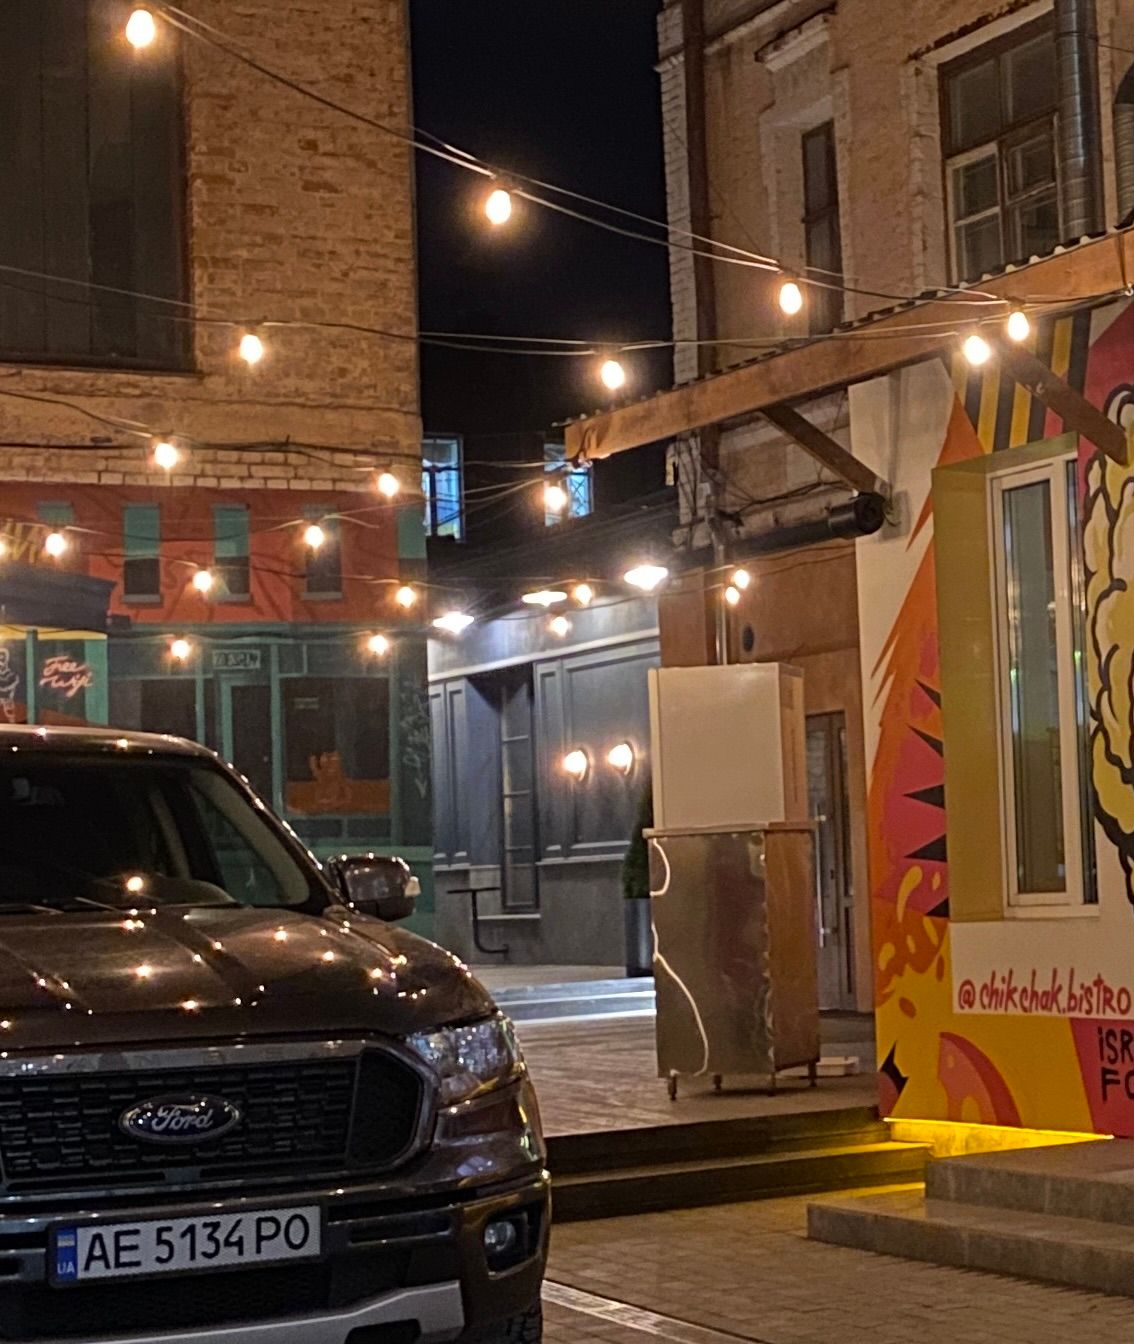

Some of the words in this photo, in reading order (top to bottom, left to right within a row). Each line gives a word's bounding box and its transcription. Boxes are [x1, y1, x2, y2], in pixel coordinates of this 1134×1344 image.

[151, 1105, 214, 1131] Ford
[83, 1228, 142, 1273] AE
[155, 1218, 244, 1264] 5134
[255, 1213, 310, 1255] PO
[57, 1261, 75, 1275] UA
